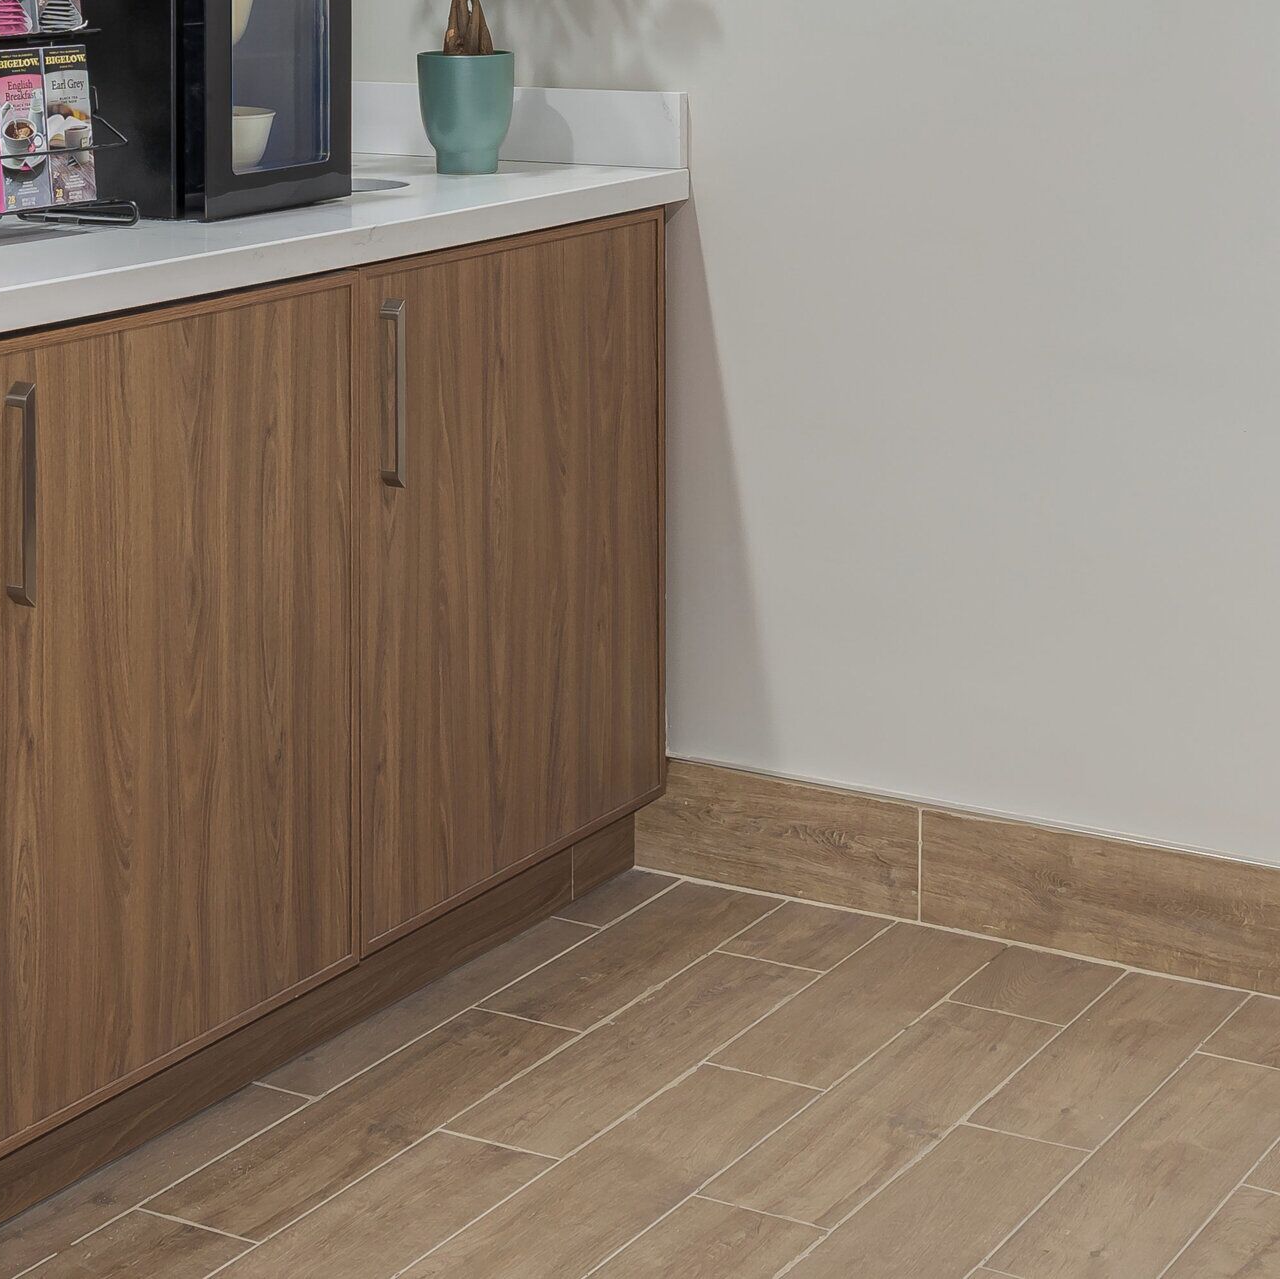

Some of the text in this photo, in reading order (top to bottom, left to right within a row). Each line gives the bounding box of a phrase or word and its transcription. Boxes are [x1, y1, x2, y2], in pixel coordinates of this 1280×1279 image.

[7, 80, 33, 92] English
[52, 79, 84, 91] Earl Grey
[5, 91, 36, 101] Breakfast
